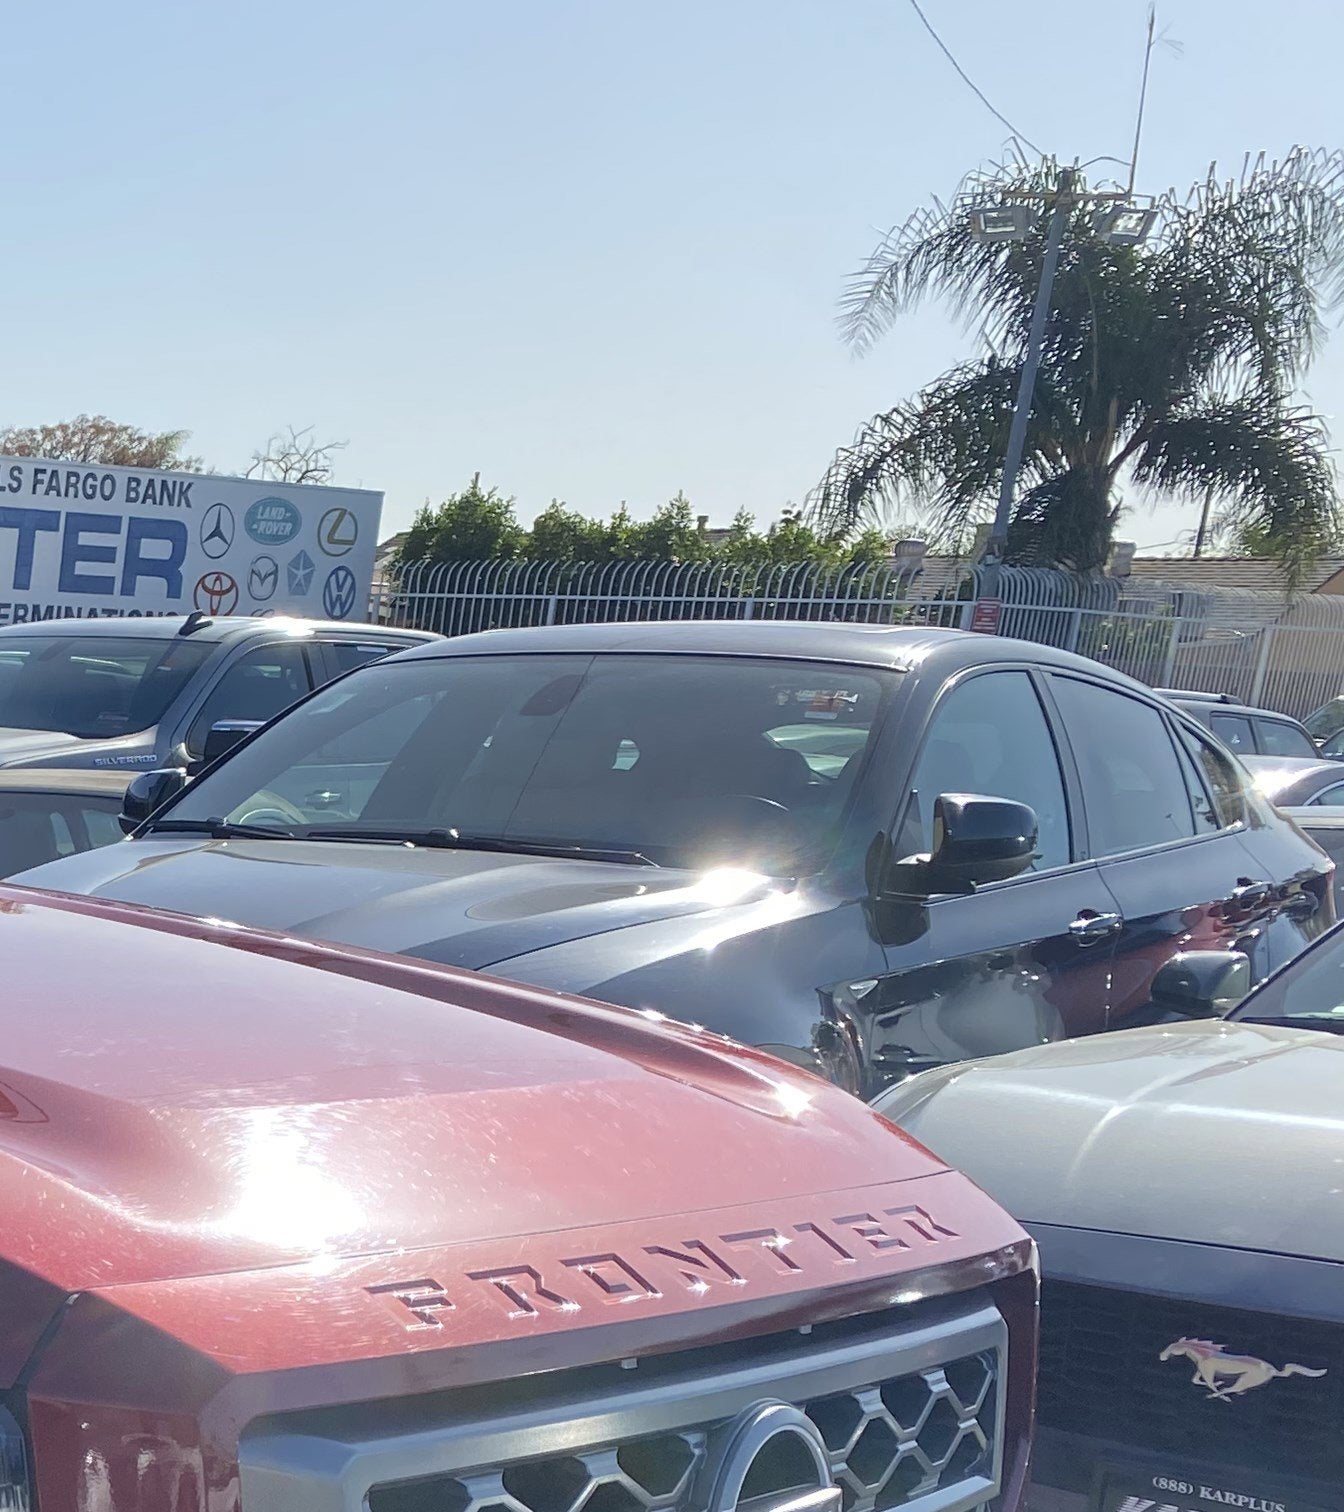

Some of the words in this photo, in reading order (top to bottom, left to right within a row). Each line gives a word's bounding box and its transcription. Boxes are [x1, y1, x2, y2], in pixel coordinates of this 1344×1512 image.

[31, 467, 116, 501] FARGO
[125, 475, 194, 509] BANK
[364, 1203, 961, 1332] FRONTIER
[1152, 1475, 1195, 1495] (888)
